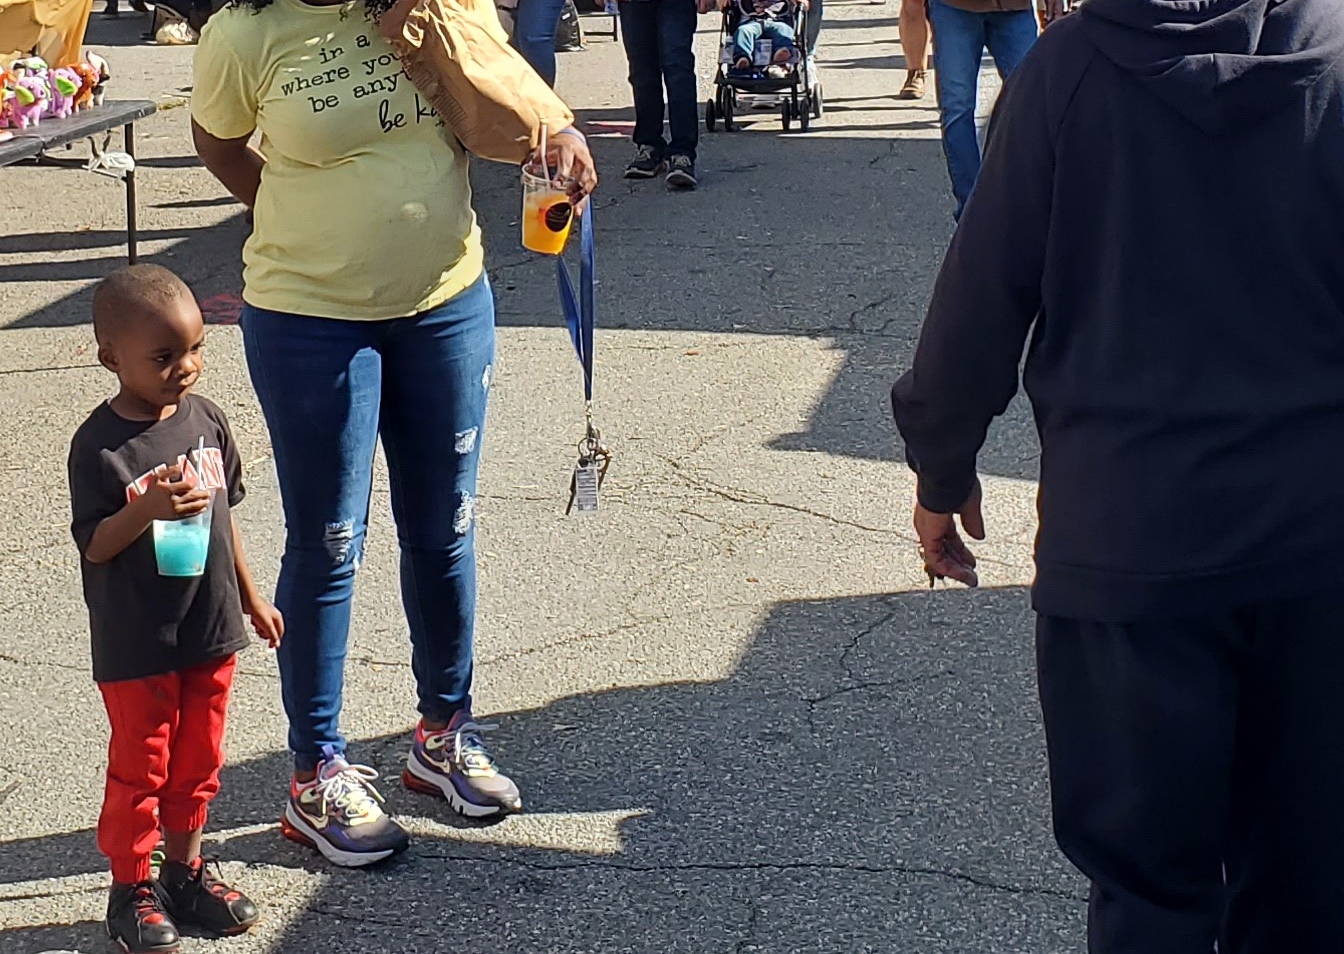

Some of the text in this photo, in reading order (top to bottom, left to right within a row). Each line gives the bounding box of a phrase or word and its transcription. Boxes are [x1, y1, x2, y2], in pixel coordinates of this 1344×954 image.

[318, 33, 371, 65] in a
[280, 65, 351, 97] where
[307, 94, 340, 113] be
[378, 98, 408, 133] be
